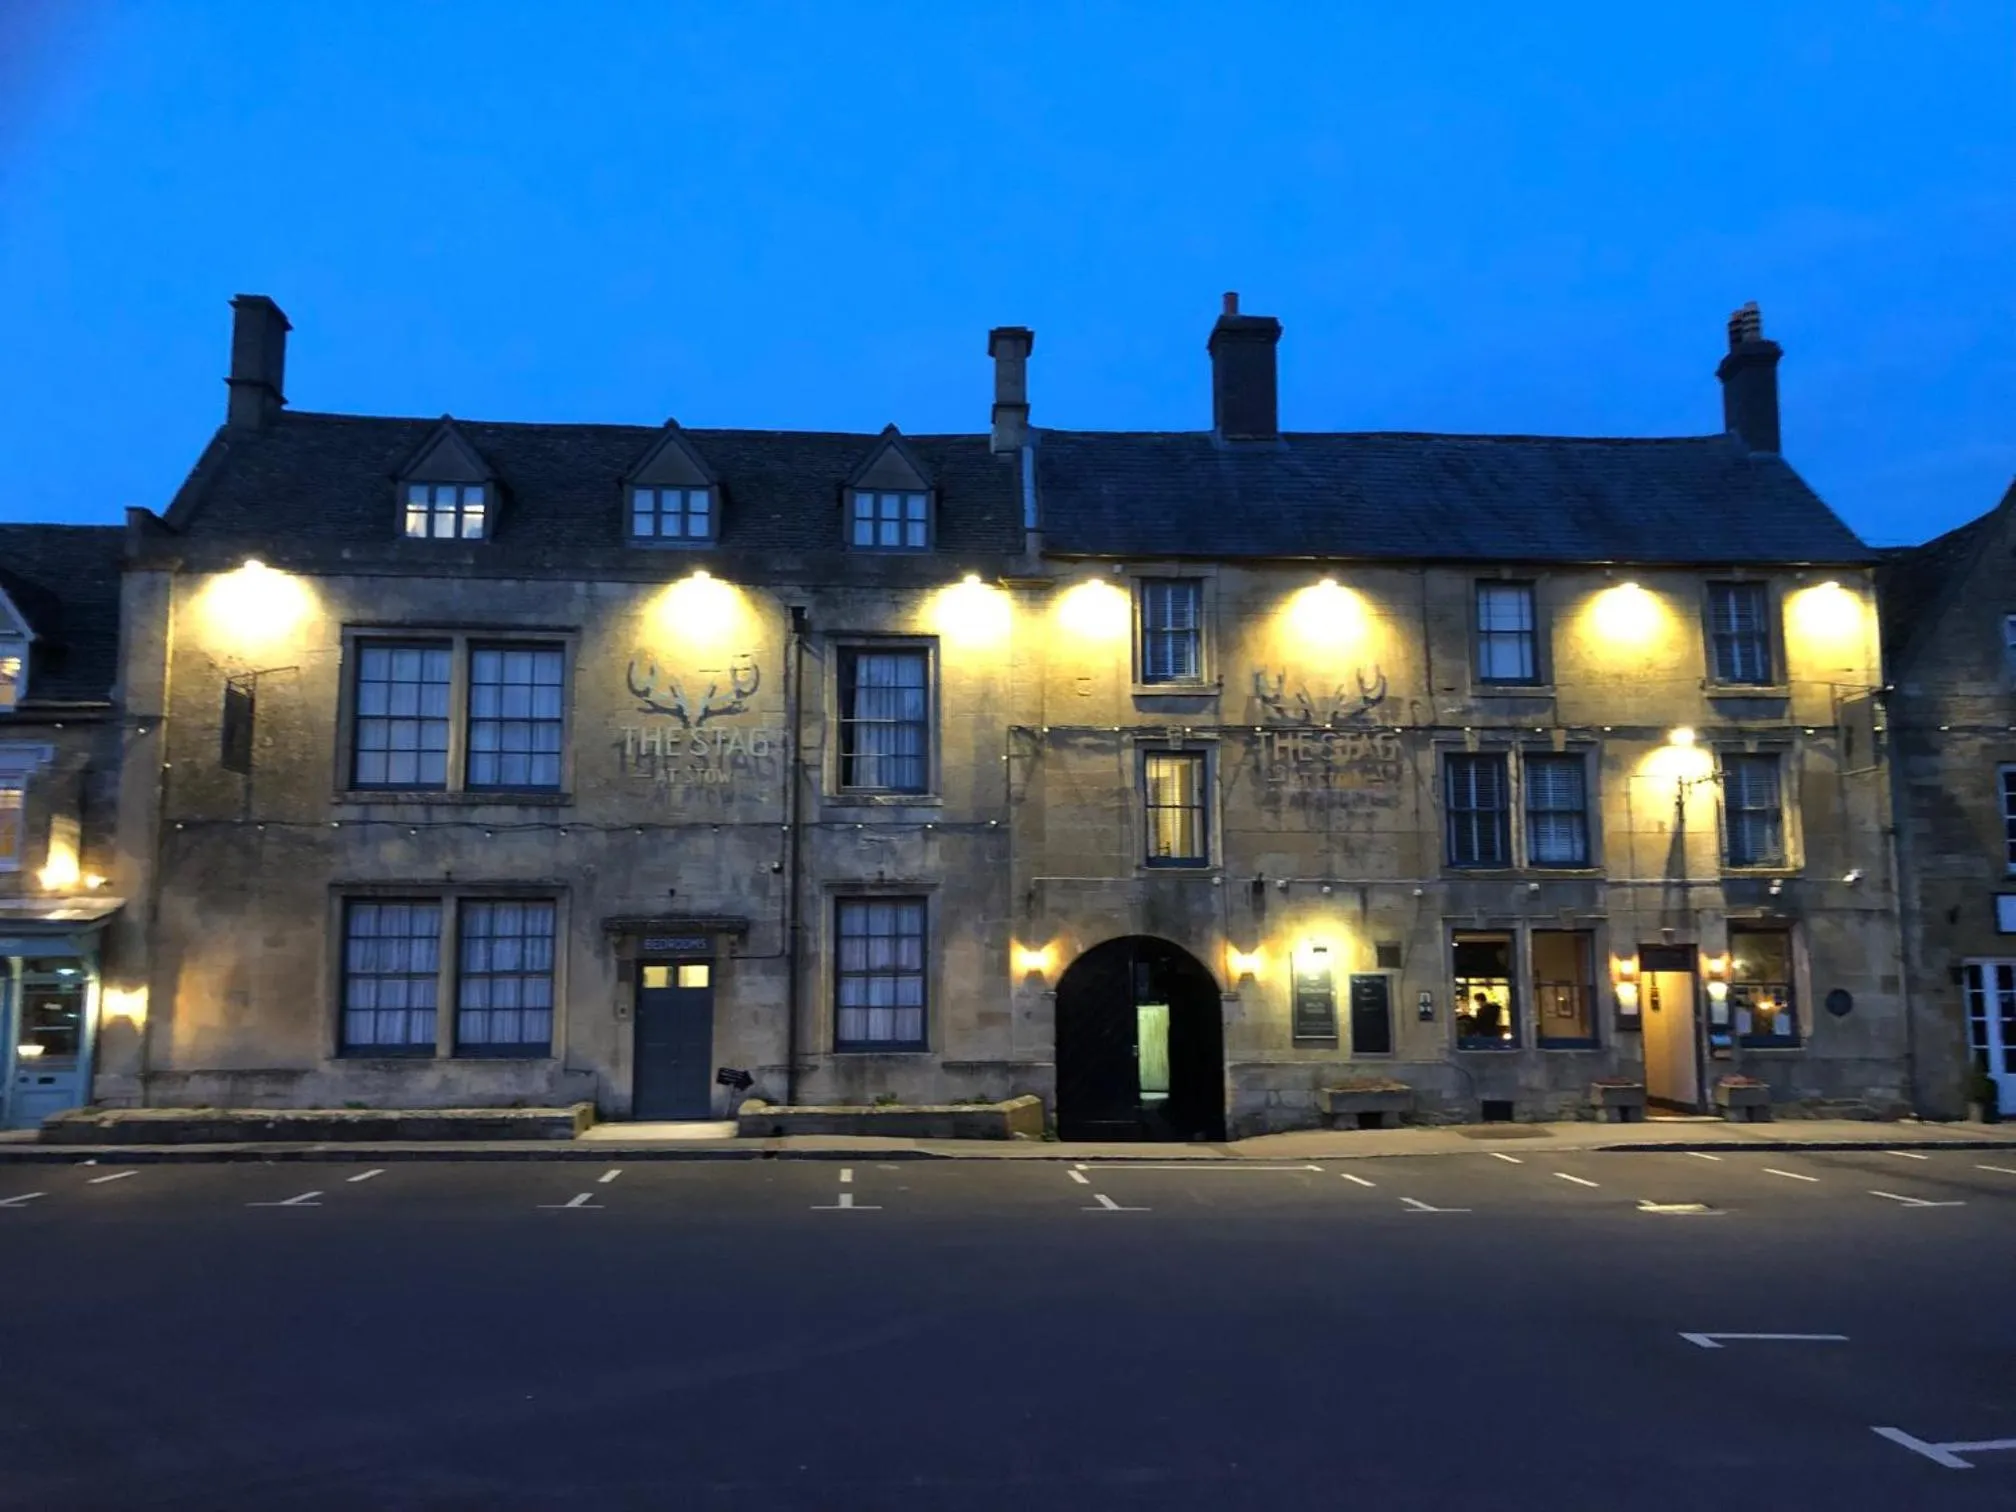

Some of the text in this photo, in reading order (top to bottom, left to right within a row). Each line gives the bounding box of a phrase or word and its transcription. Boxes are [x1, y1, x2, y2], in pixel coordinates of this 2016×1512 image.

[619, 725, 769, 757] THE STAG
[1253, 731, 1313, 761] THE
